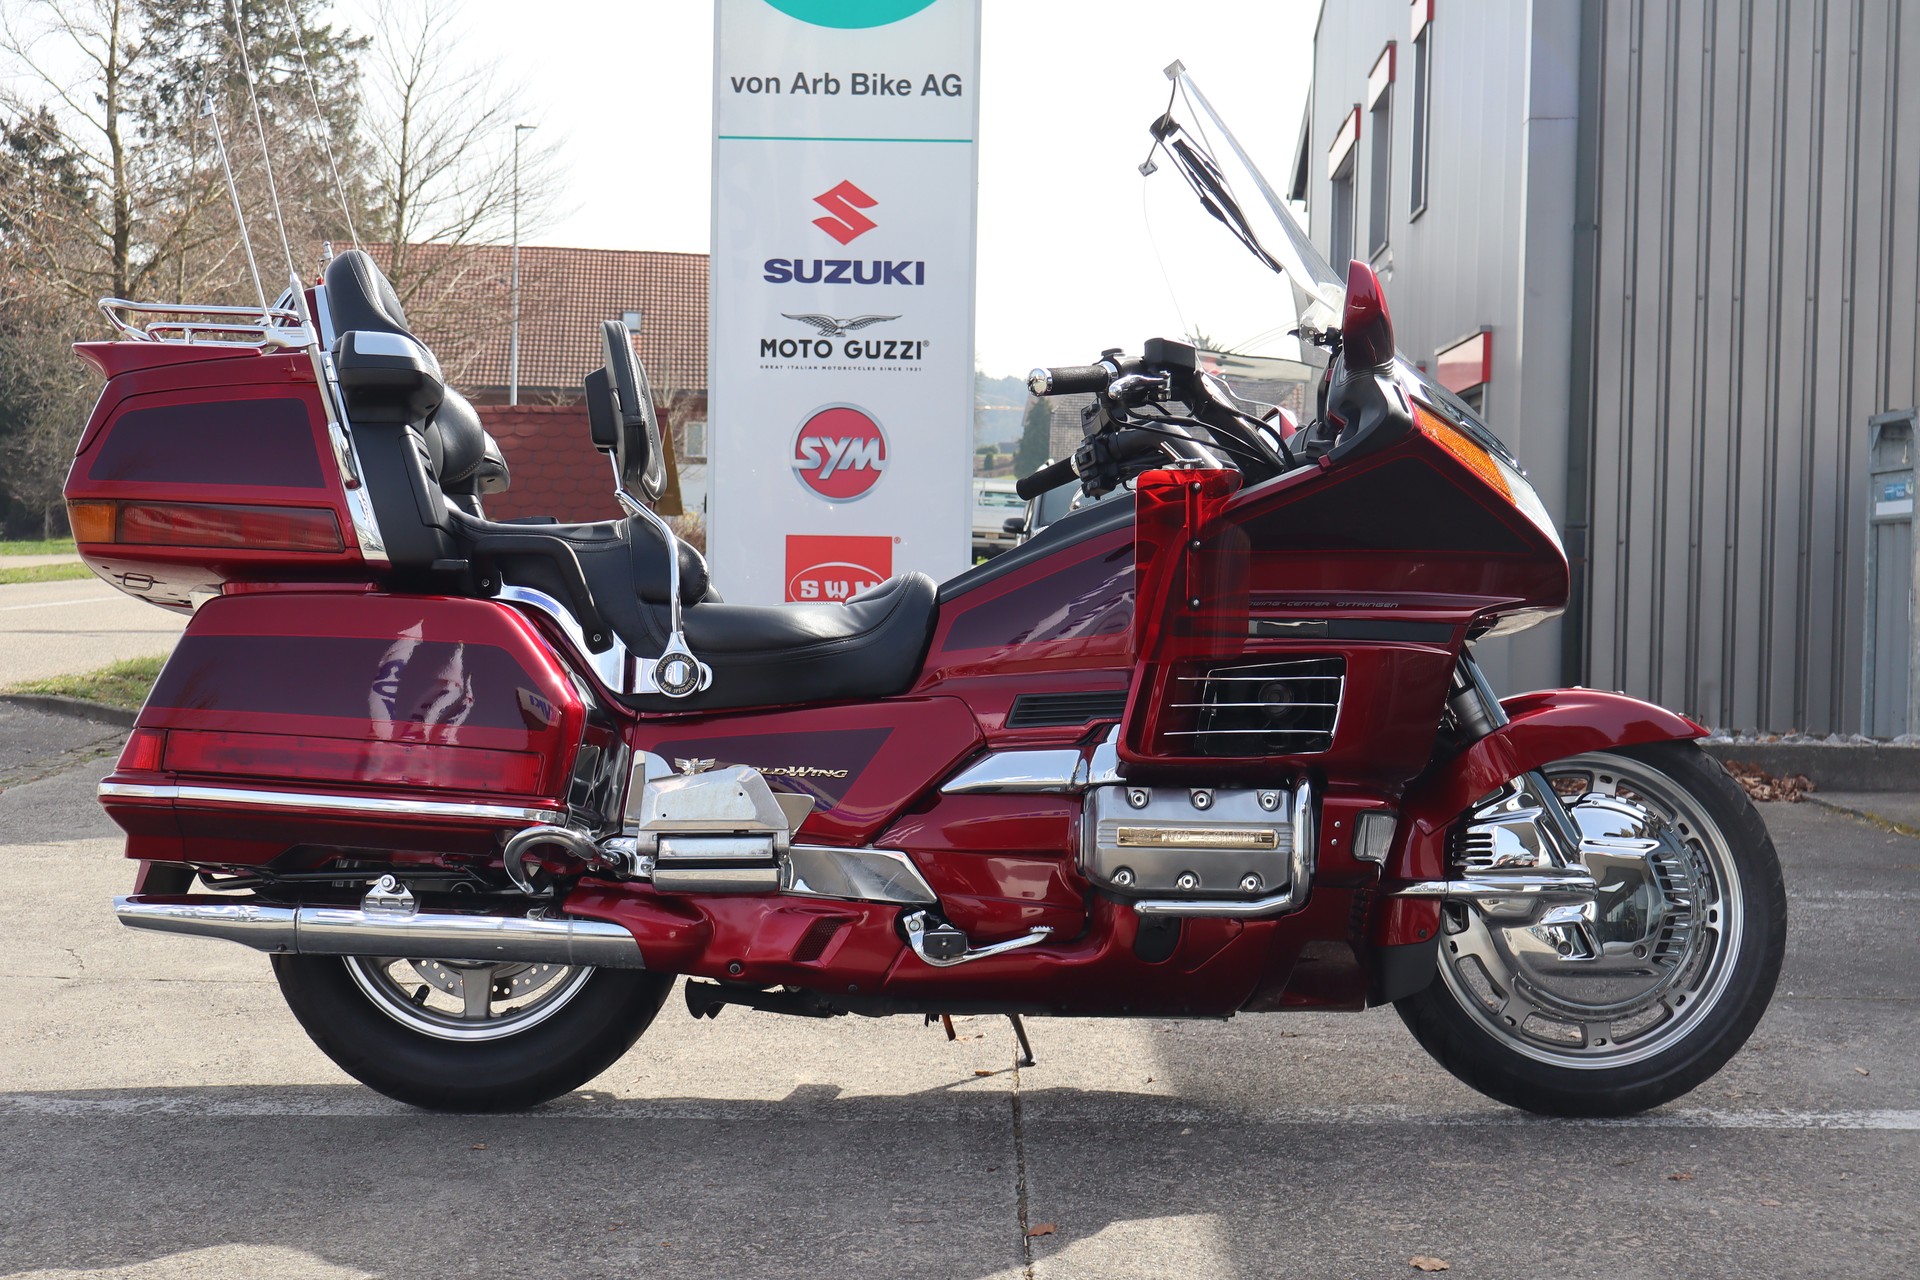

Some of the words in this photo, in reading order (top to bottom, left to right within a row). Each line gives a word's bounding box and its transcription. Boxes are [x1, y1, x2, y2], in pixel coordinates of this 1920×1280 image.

[731, 76, 781, 94] von
[790, 72, 841, 95] Arb
[851, 73, 912, 96] Bike
[920, 74, 963, 97] AG
[763, 258, 925, 286] SUZUKI
[760, 338, 833, 359] MOTO
[843, 340, 922, 361] GUZZI
[795, 436, 887, 480] SYM
